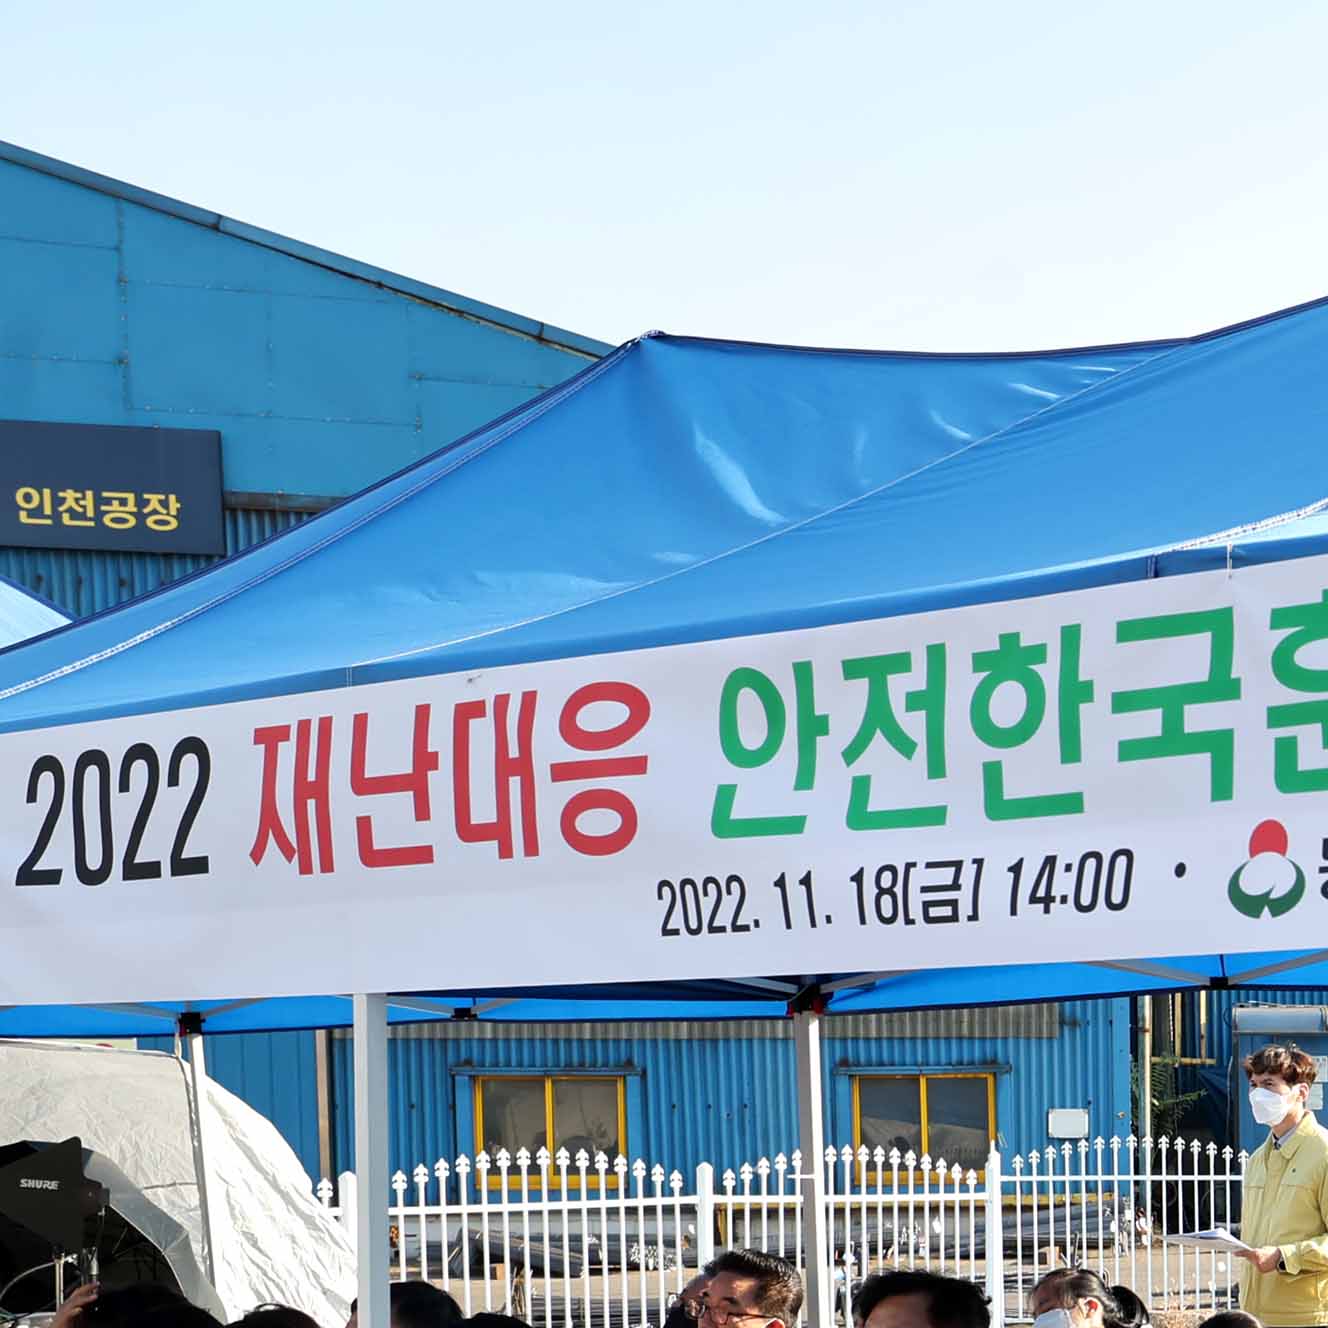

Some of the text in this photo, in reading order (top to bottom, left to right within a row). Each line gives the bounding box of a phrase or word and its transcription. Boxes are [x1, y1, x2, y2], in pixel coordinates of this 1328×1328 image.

[14, 486, 181, 532] 인천공장
[15, 735, 212, 887] 2022
[250, 681, 651, 875] 재난대응
[657, 874, 761, 937] 2022.
[774, 869, 833, 930] 11.
[850, 856, 984, 926] 18[금]
[1007, 847, 1135, 917] 14:00
[20, 1178, 60, 1190] SHURE
